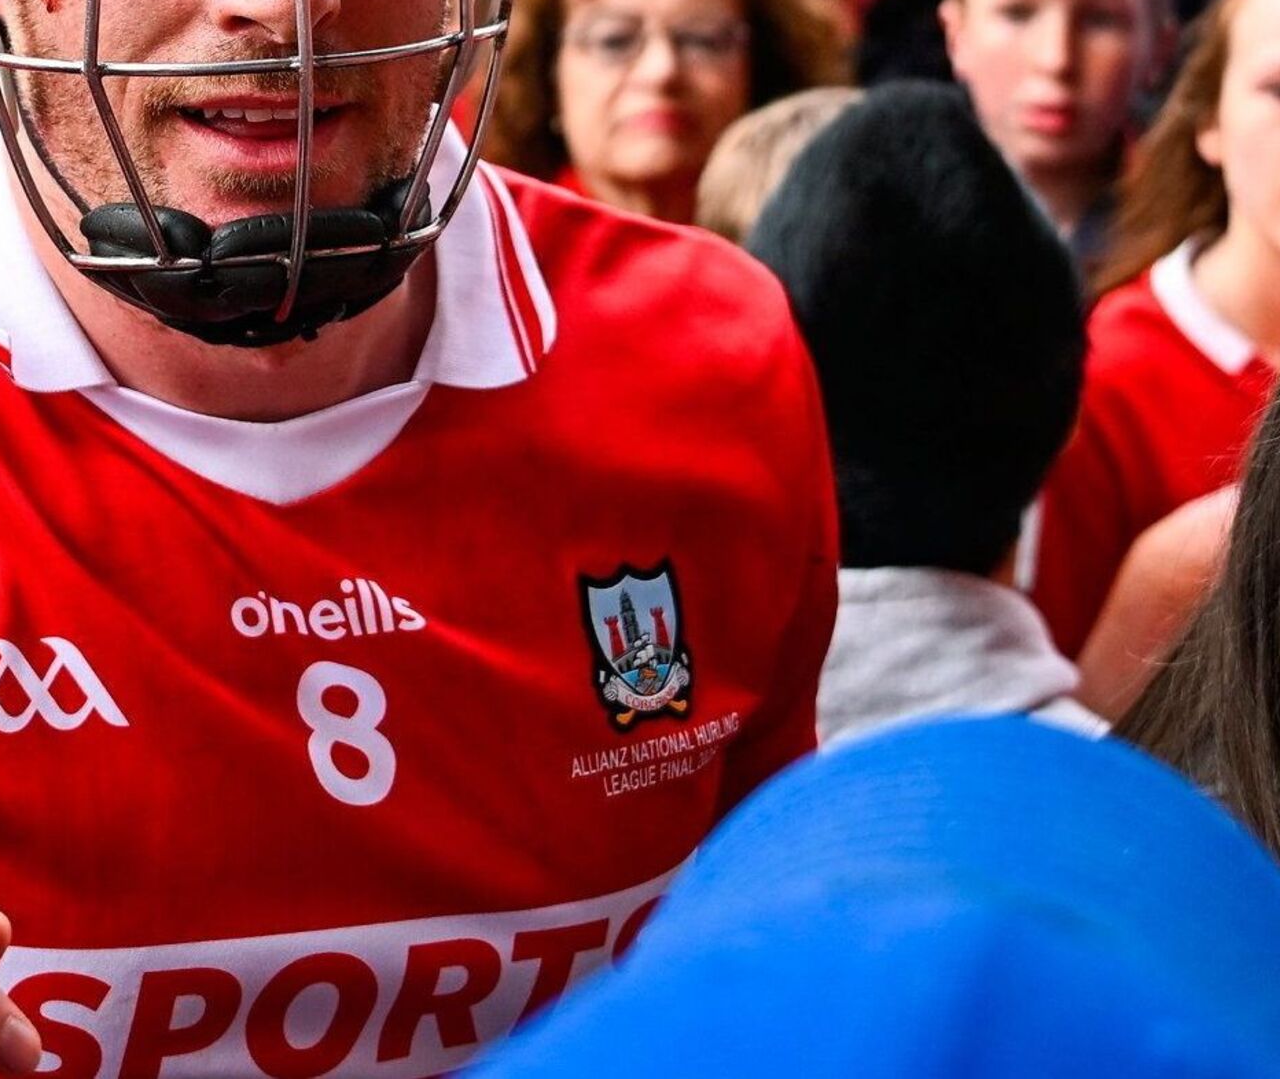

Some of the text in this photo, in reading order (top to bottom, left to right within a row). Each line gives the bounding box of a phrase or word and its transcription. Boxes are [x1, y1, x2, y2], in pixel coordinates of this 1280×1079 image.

[231, 578, 427, 640] o'neills
[296, 660, 397, 806] 8
[571, 712, 739, 779] ALLIANZ NATIONAL HURLING
[603, 765, 657, 797] LEAGUE
[660, 755, 695, 782] FINAL
